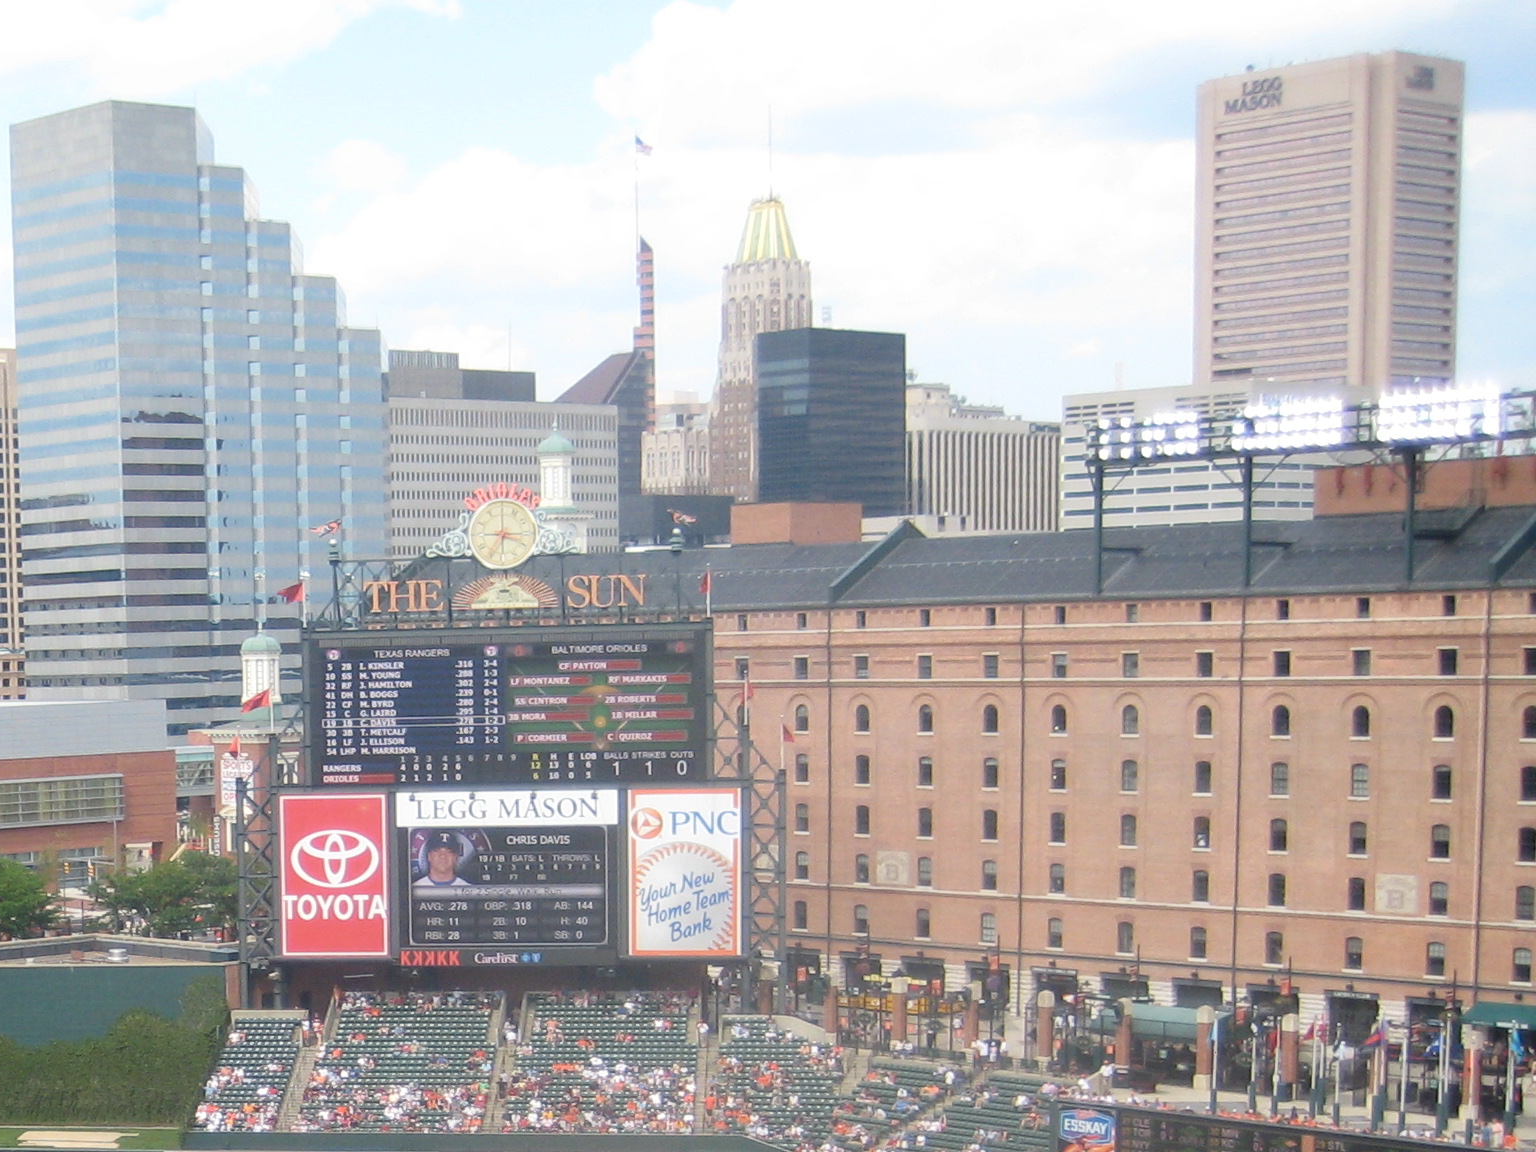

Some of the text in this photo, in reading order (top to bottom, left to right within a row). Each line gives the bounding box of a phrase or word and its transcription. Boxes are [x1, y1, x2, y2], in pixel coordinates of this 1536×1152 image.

[1242, 75, 1283, 96] LEGG
[1224, 91, 1283, 115] MASON
[465, 482, 540, 511] ORIOLES
[364, 574, 648, 612] THE SUN
[374, 649, 450, 658] TEXAS RANGERS
[552, 646, 604, 654] BALTIMORE
[368, 662, 404, 670] KINSLER
[524, 677, 570, 685] MONTANEZ
[623, 675, 667, 683] MARKAKIS
[529, 697, 567, 705] CINTRON
[371, 719, 396, 727] DAVIS
[370, 728, 407, 736] METCALF
[528, 734, 567, 742] CORMIER
[373, 747, 416, 755] HARRISON
[613, 761, 687, 775] 1 1 0
[415, 797, 598, 819] LEGG MASON
[669, 810, 738, 835] PNC
[507, 836, 570, 845] CHRIS DAVIS
[639, 872, 714, 911] Your New
[282, 895, 387, 920] TOYOTA
[419, 903, 444, 911] AVG:
[512, 902, 531, 910] .318
[553, 902, 593, 910] AB: 144
[648, 890, 729, 926] Home Team
[427, 918, 444, 926] HR:
[576, 917, 588, 925] 40
[669, 912, 712, 942] Bank
[425, 931, 460, 940] RBI: 28
[515, 931, 519, 939] 1
[555, 931, 582, 939] SB: 0
[474, 953, 519, 964] CareFirst
[1064, 1118, 1108, 1134] ESSKAY
